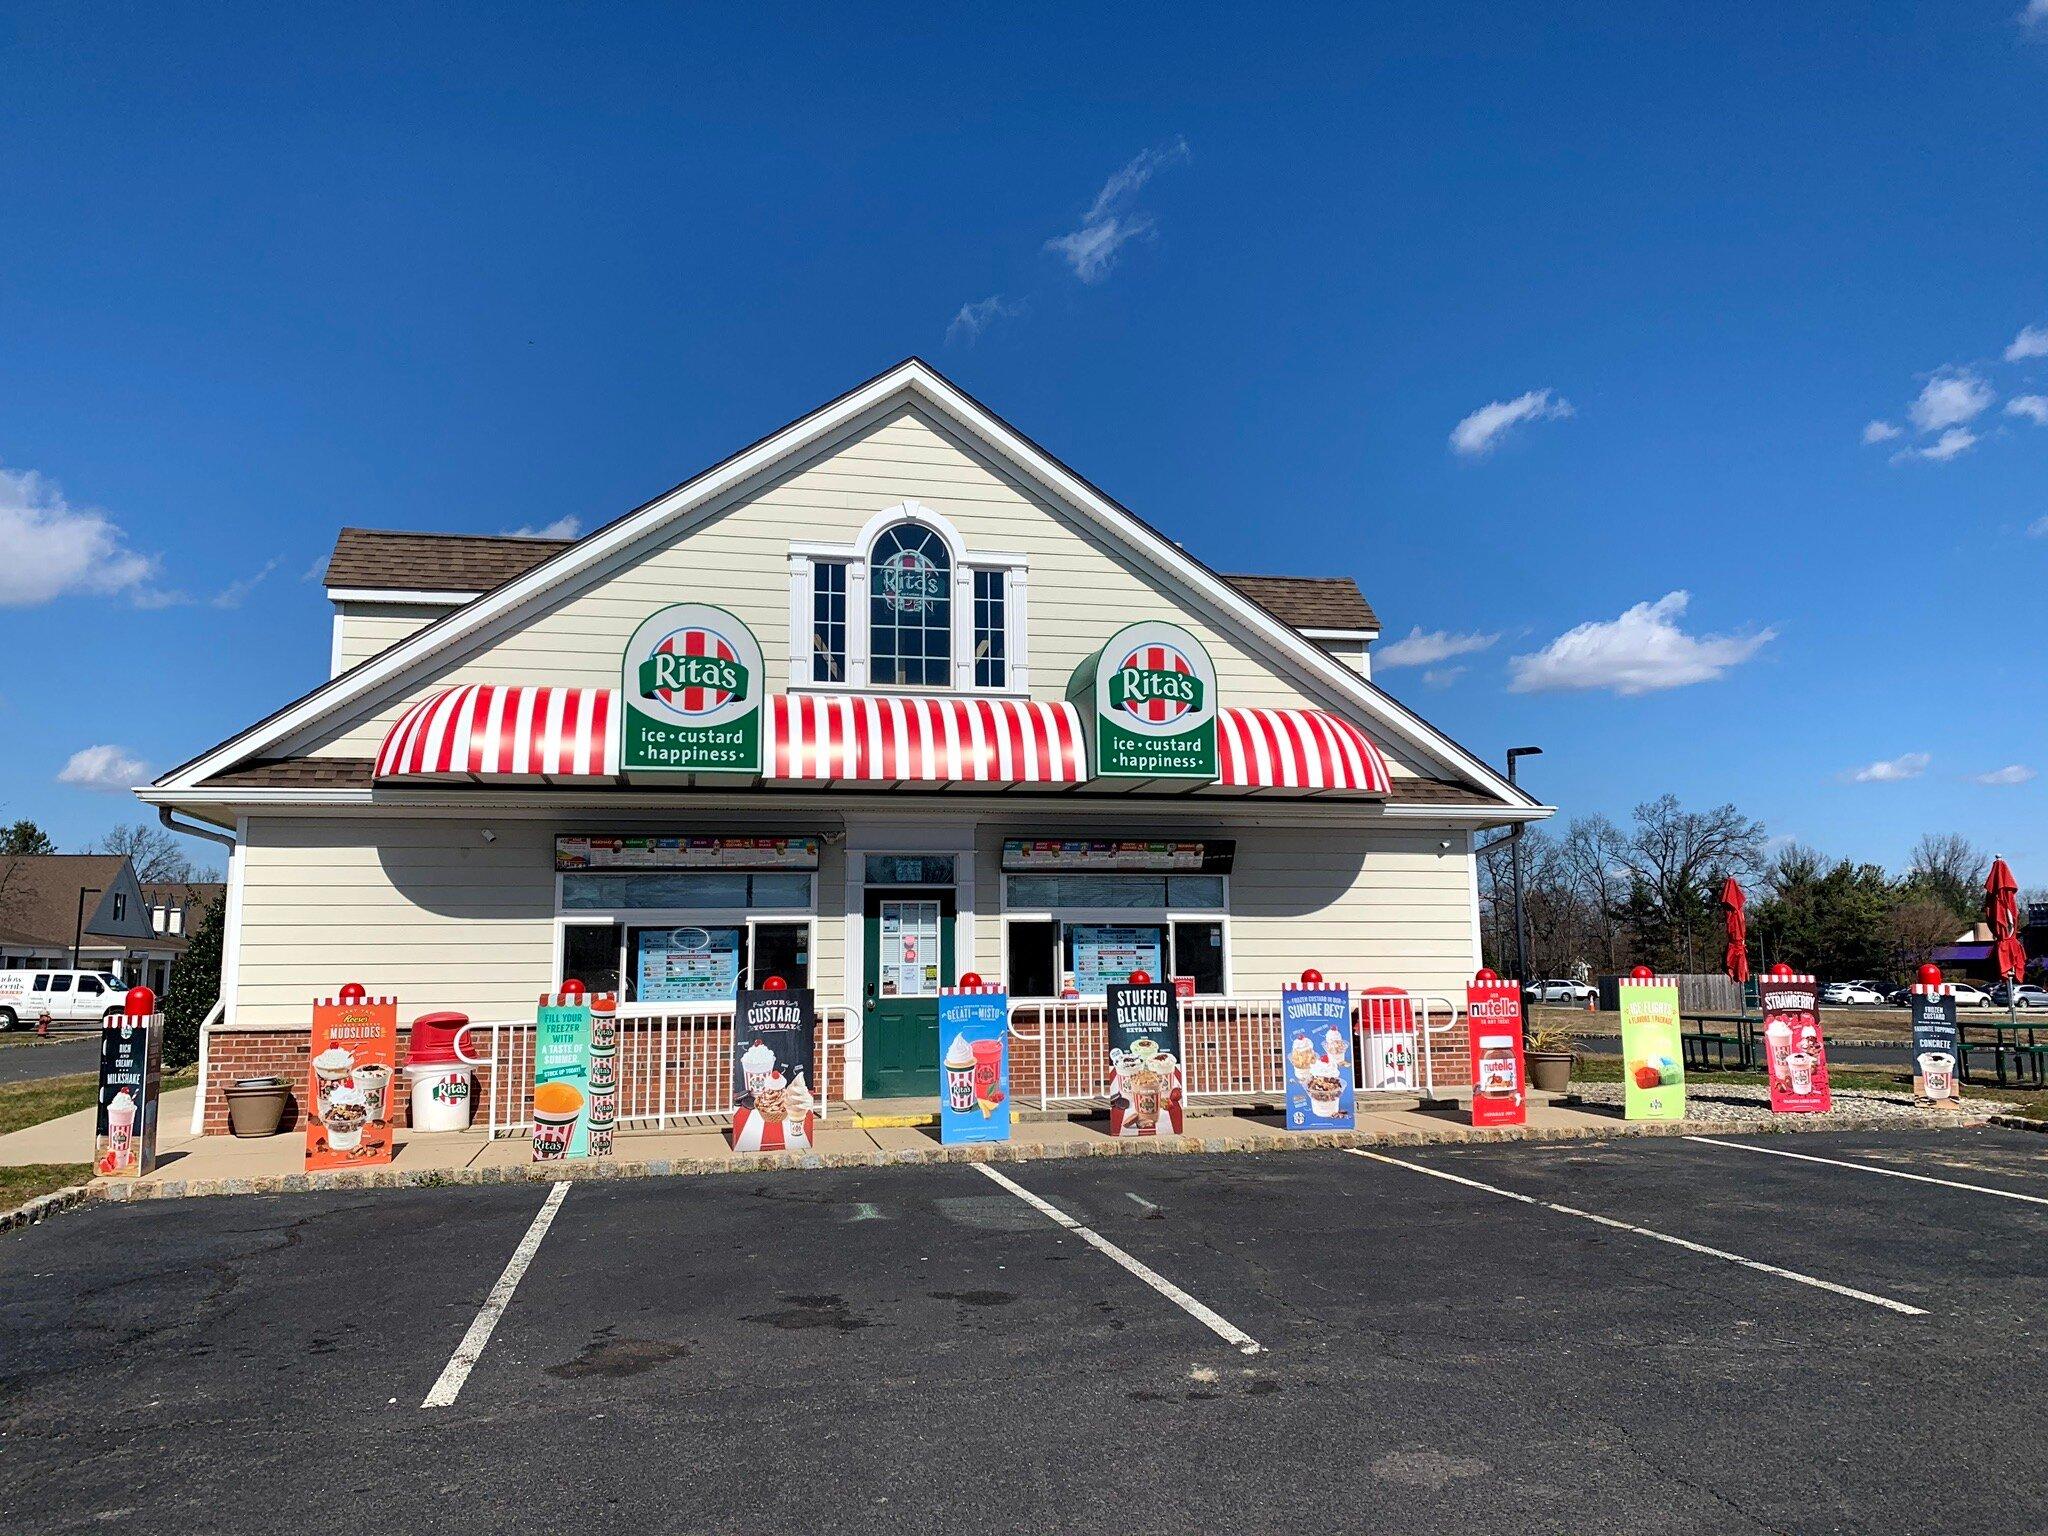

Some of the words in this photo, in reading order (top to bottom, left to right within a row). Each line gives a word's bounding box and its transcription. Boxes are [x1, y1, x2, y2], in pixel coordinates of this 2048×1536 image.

[655, 654, 737, 689] Rita's
[1123, 668, 1194, 701] Rita's
[641, 727, 665, 742] ice
[678, 729, 743, 744] custard
[1113, 737, 1134, 750] ice
[1145, 738, 1201, 752] custard
[648, 745, 736, 764] happiness
[1120, 753, 1197, 770] happiness
[1117, 989, 1167, 1006] STUFFED
[1764, 994, 1815, 1010] STRAWBERRY
[947, 1008, 971, 1020] GELATI
[978, 1007, 1000, 1019] MISTO
[1116, 1006, 1169, 1023] BLENDINI
[1288, 1002, 1322, 1019] SUNDAE
[1323, 1003, 1345, 1019] BEST
[1471, 999, 1517, 1016] nutella
[1924, 1006, 1944, 1014] FROZEN
[544, 1013, 560, 1023] FILL
[562, 1013, 583, 1023] YOUR
[748, 1007, 801, 1024] CUSTARD,
[1923, 1012, 1946, 1020] CUSTARD
[330, 1026, 381, 1040] MUDSLIDES
[546, 1024, 580, 1033] FREEZER
[552, 1034, 574, 1043] WITH
[1919, 1039, 1951, 1049] CONCRETE
[541, 1045, 547, 1054] A
[549, 1044, 573, 1054] TASTE
[573, 1044, 583, 1053] OF
[1484, 1058, 1513, 1072] nutella
[107, 1073, 141, 1085] MILKSHAKE
[438, 1082, 467, 1097] Rita's
[533, 1138, 562, 1151] Rita's
